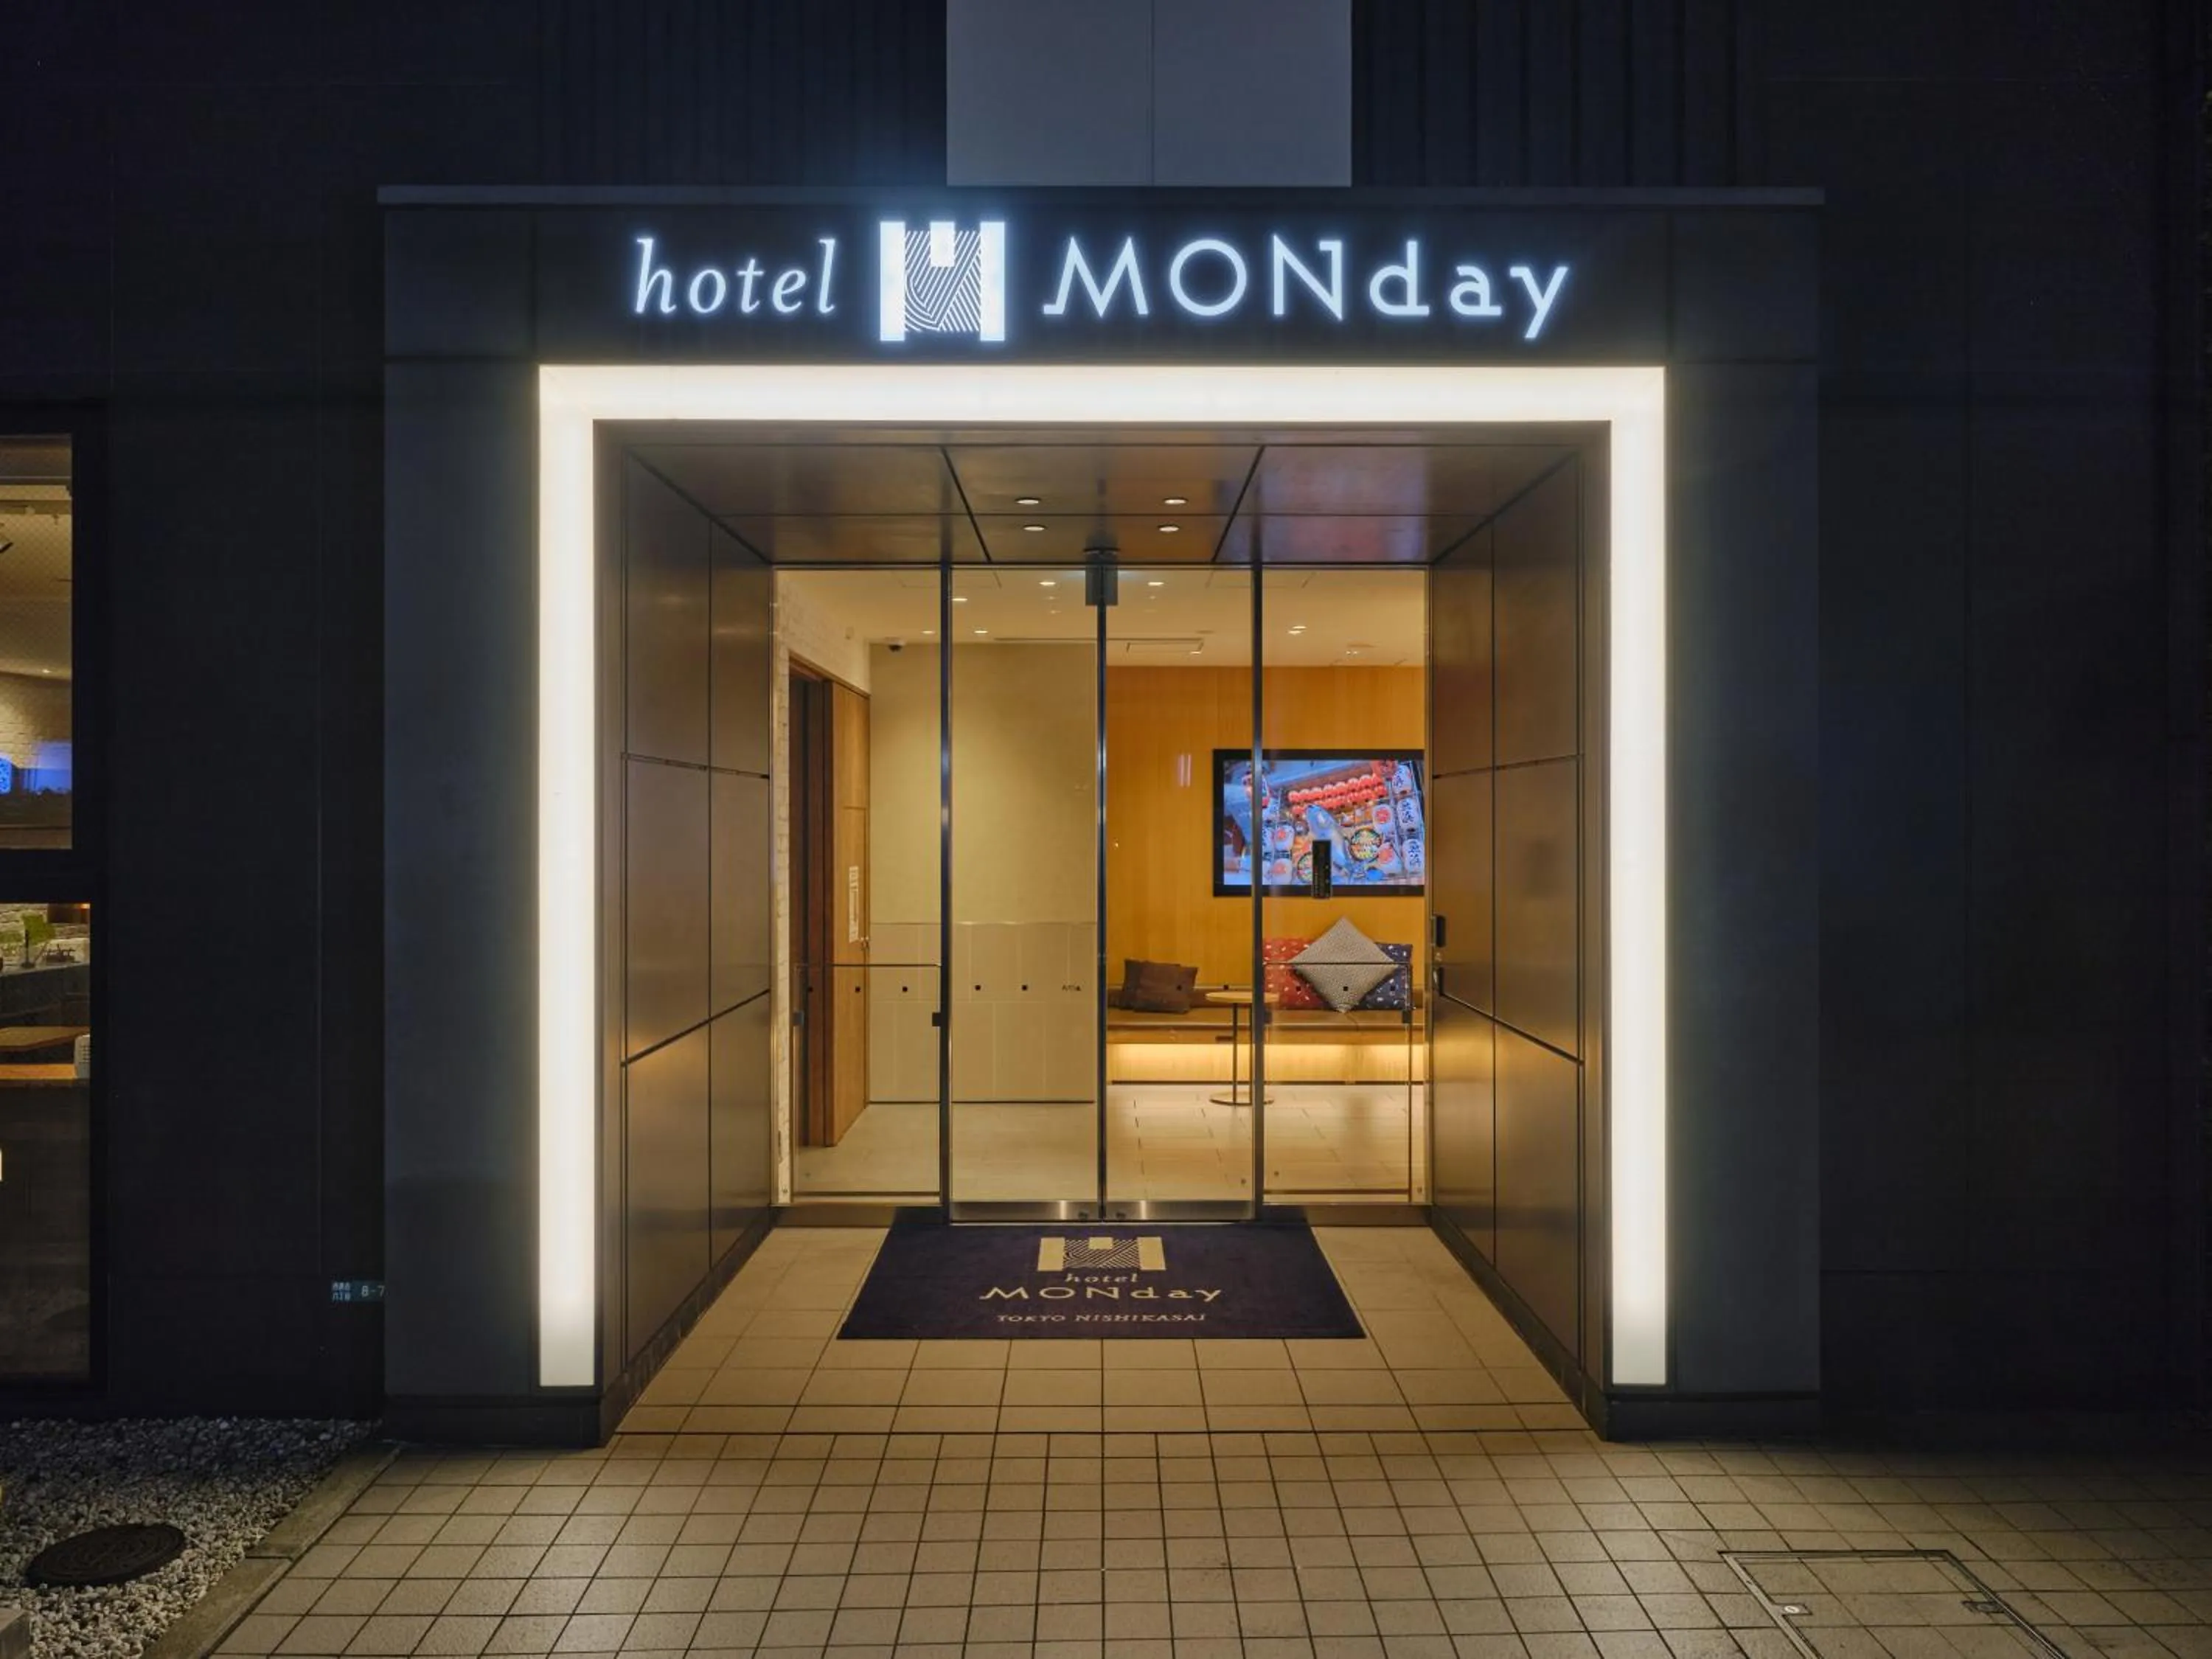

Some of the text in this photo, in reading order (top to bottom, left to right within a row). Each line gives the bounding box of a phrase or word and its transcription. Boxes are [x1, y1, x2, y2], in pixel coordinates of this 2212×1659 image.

[635, 234, 1568, 339] hotel MONday
[1065, 1273, 1137, 1283] hotel
[979, 1287, 1221, 1302] MONday
[1075, 1313, 1205, 1322] NISHIKASAI
